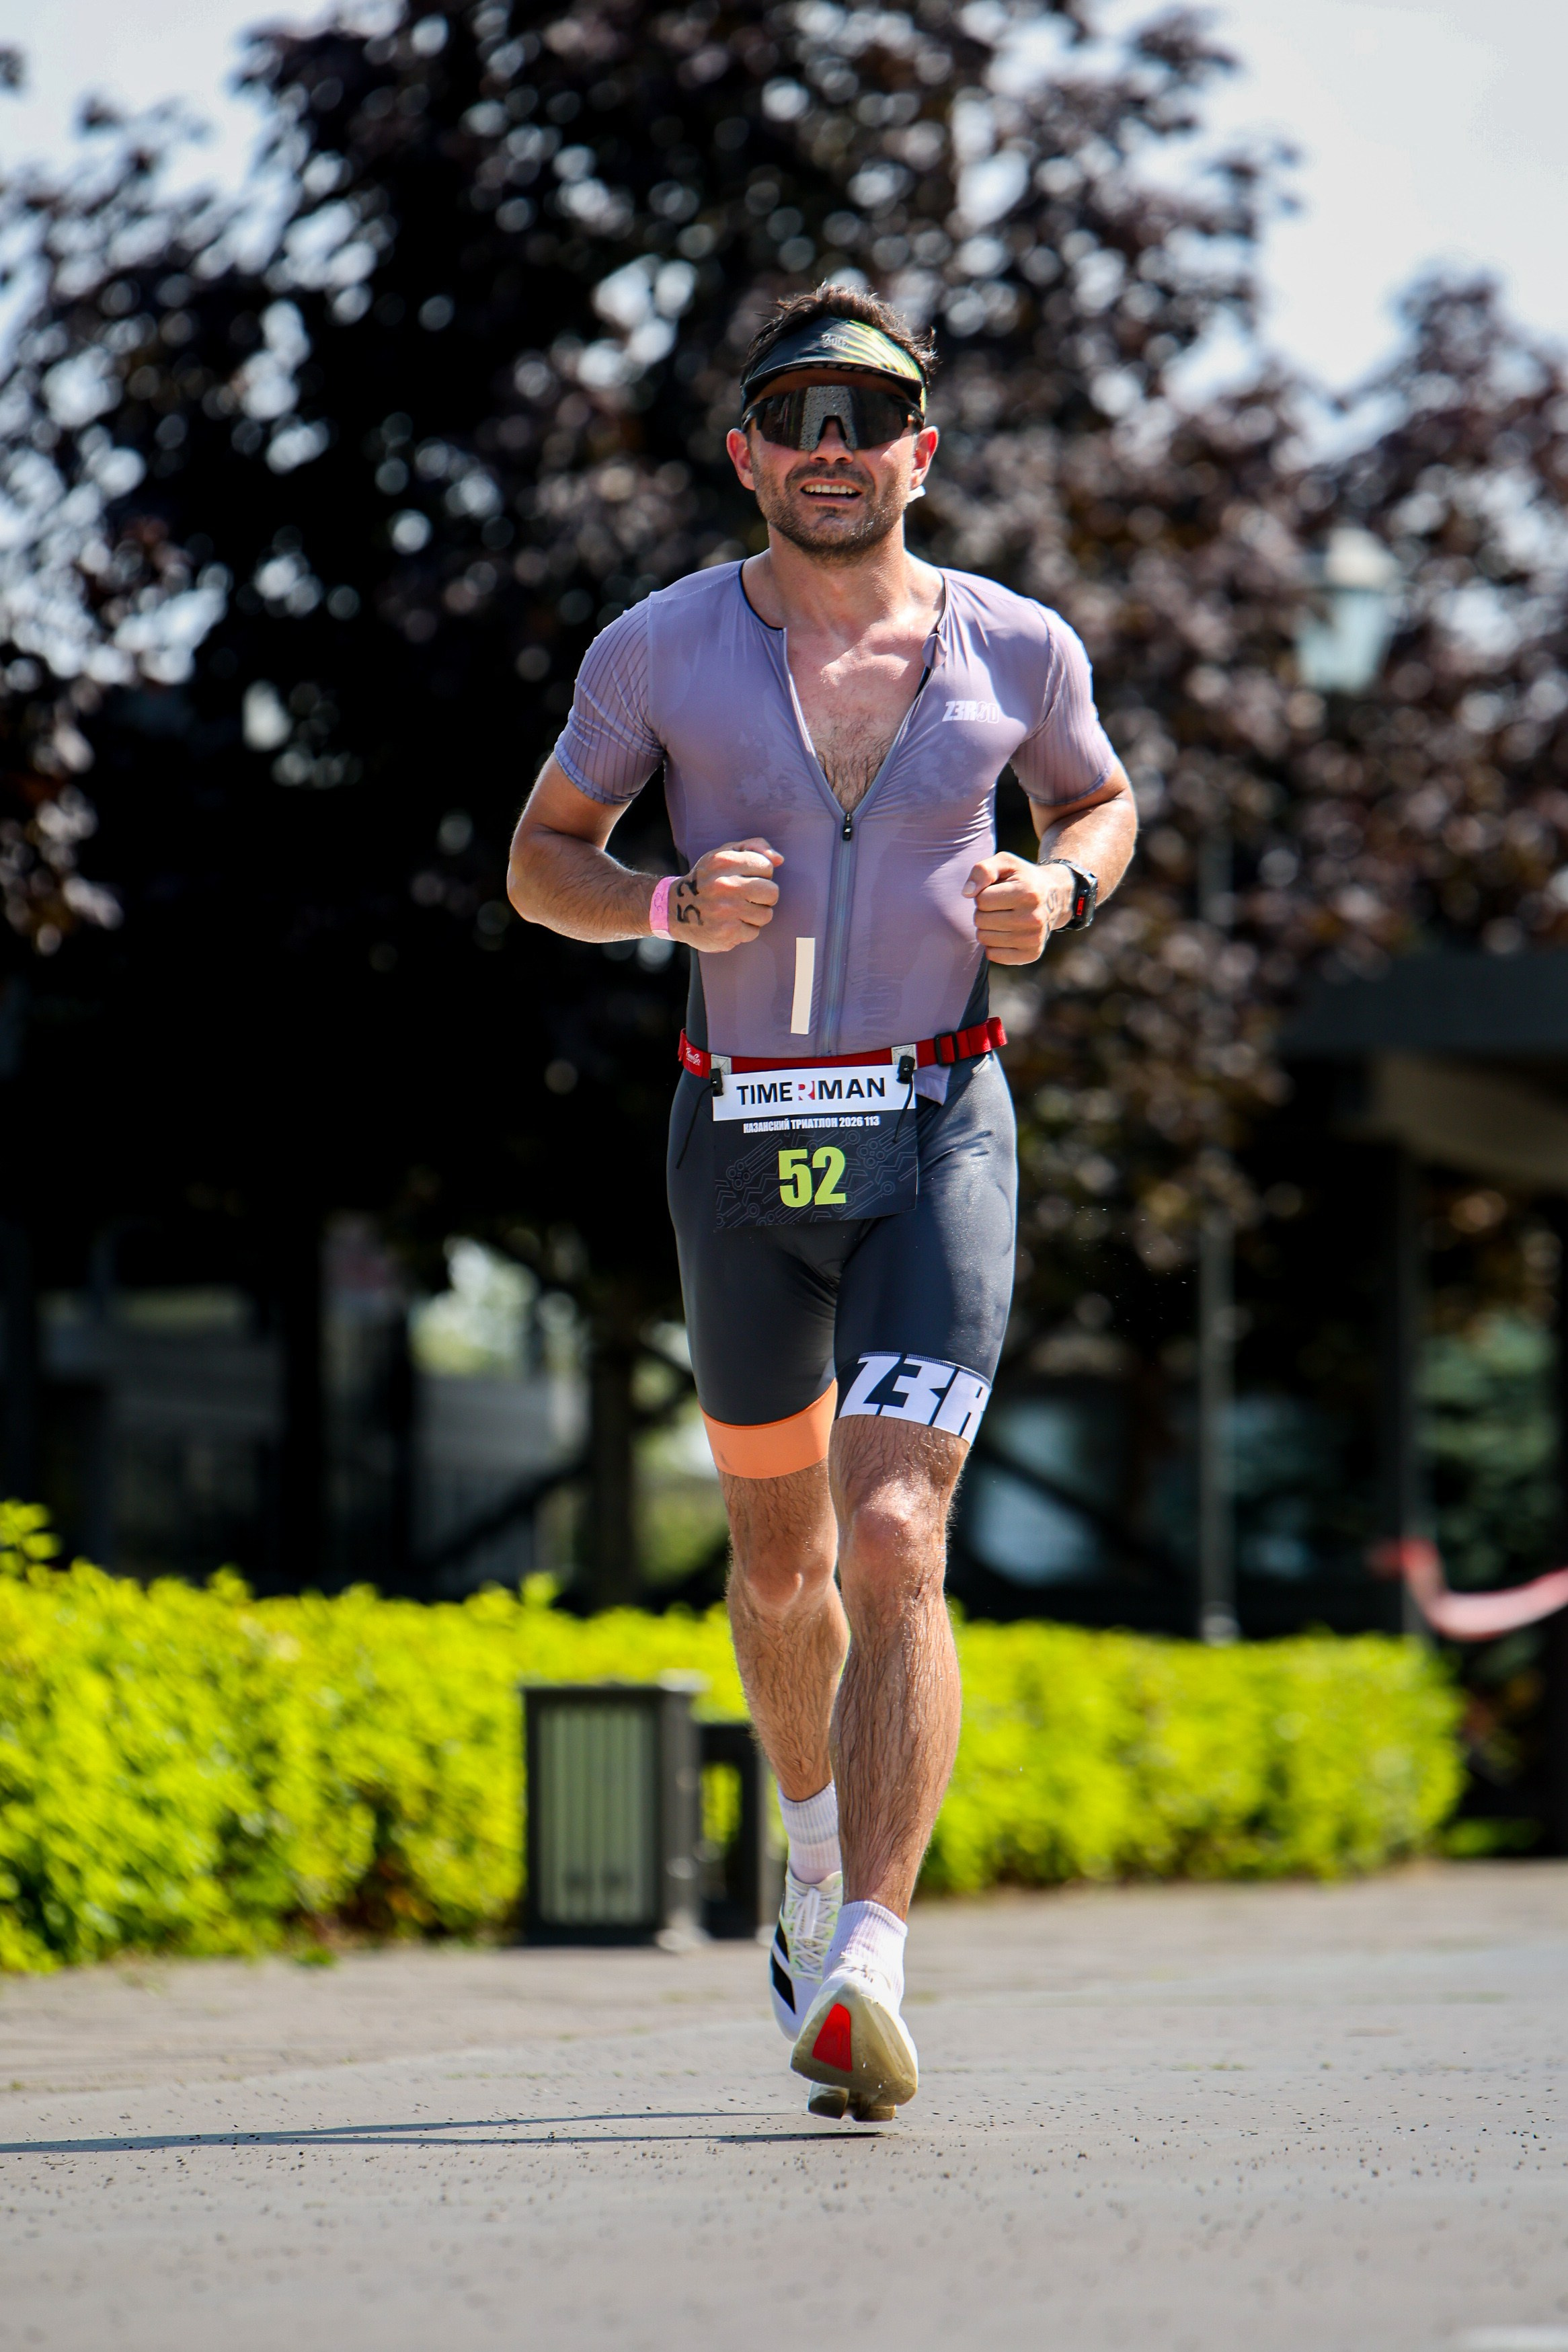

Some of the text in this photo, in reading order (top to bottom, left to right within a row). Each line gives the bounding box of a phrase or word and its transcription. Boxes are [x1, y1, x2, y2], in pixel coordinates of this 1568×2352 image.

[676, 872, 703, 925] 52
[743, 1115, 880, 1134] КАЗАНСКИЙ ТРИАТЛОН 2026 113
[778, 1146, 847, 1208] 52
